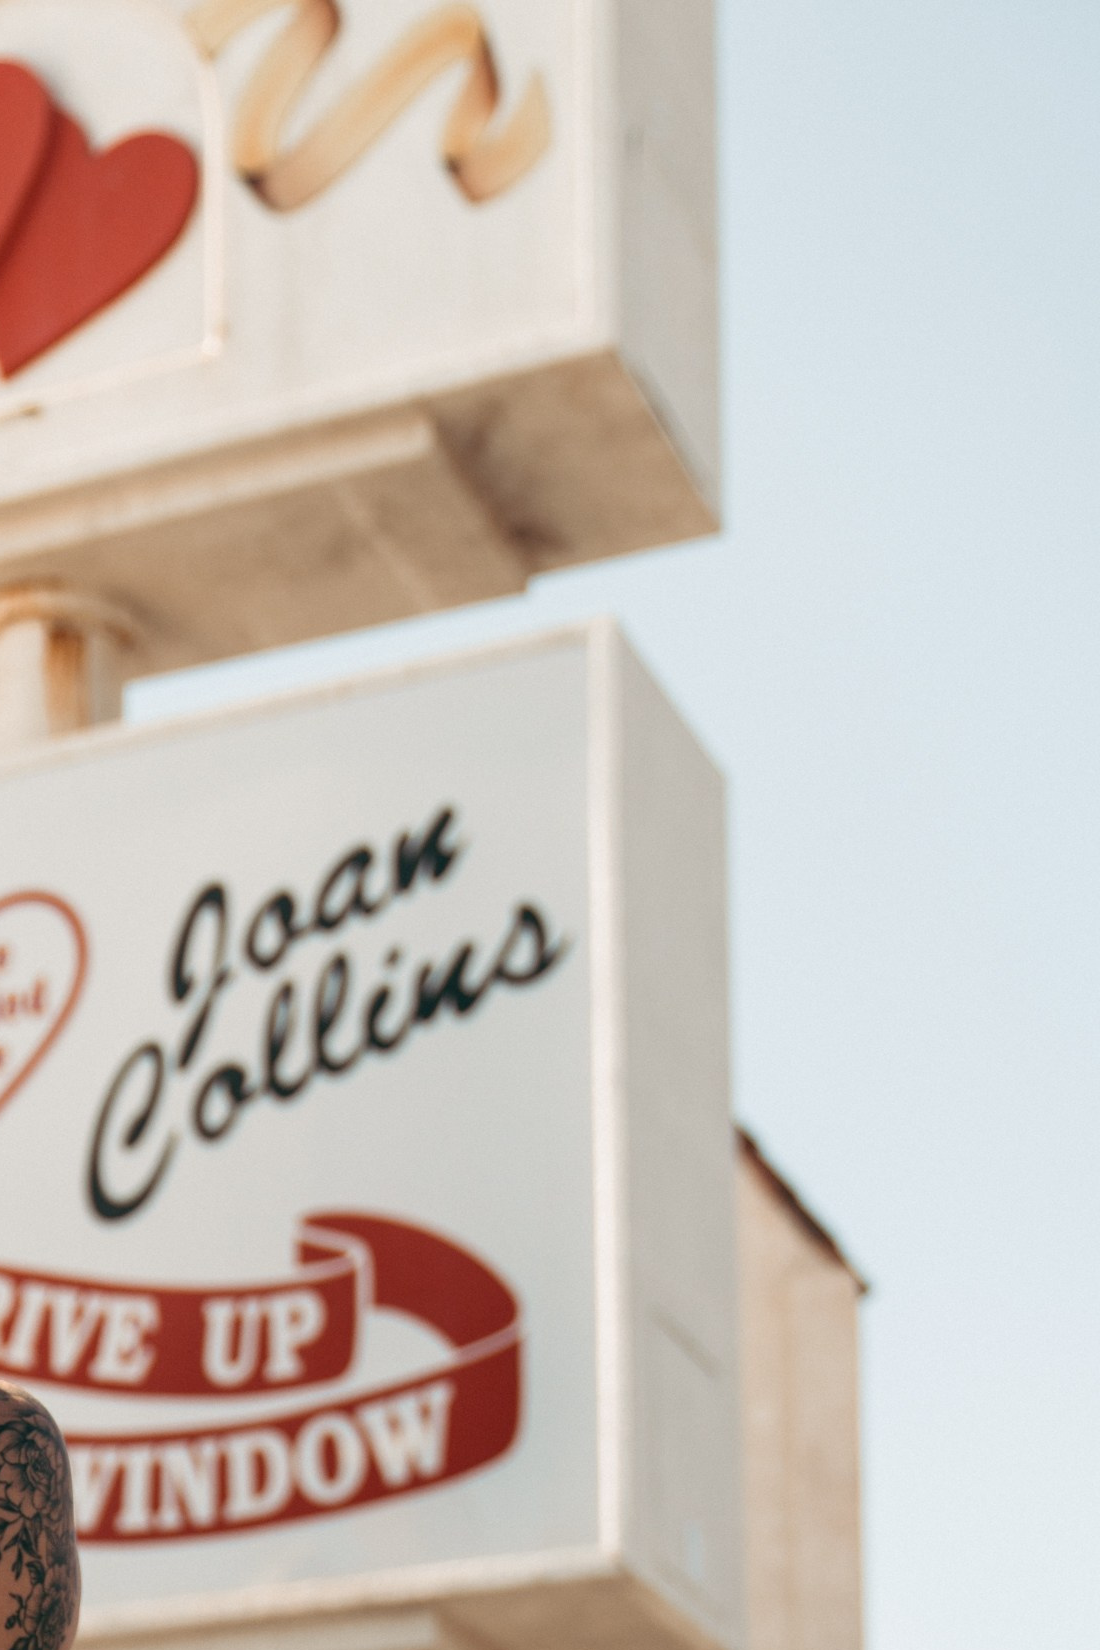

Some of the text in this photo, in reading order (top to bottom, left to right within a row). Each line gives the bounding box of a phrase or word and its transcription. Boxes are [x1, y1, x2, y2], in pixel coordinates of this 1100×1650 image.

[86, 905, 572, 1220] Collins
[168, 804, 468, 1071] Joan
[204, 1294, 324, 1384] UP
